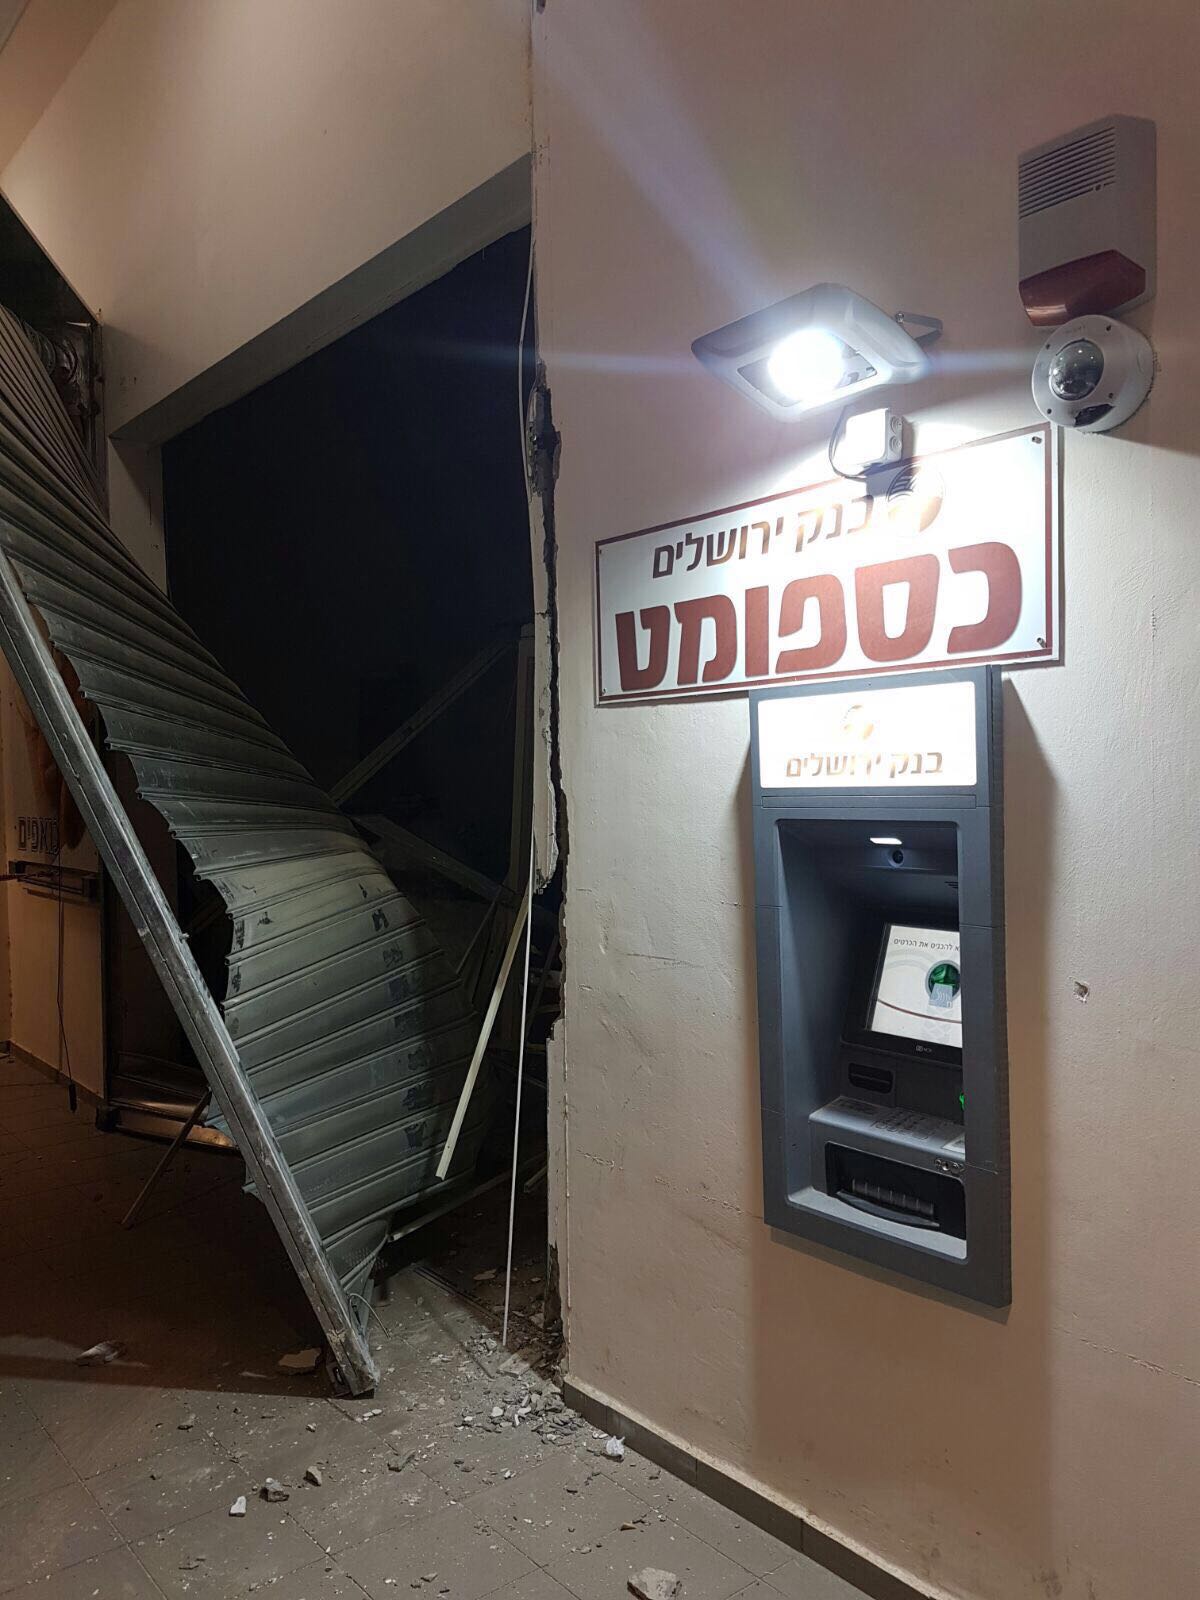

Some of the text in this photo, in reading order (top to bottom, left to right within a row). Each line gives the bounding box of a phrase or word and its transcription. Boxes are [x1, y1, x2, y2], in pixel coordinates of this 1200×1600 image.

[652, 494, 874, 579] בנק ירושלים
[615, 541, 1023, 692] כספומט
[889, 752, 944, 779] בנק
